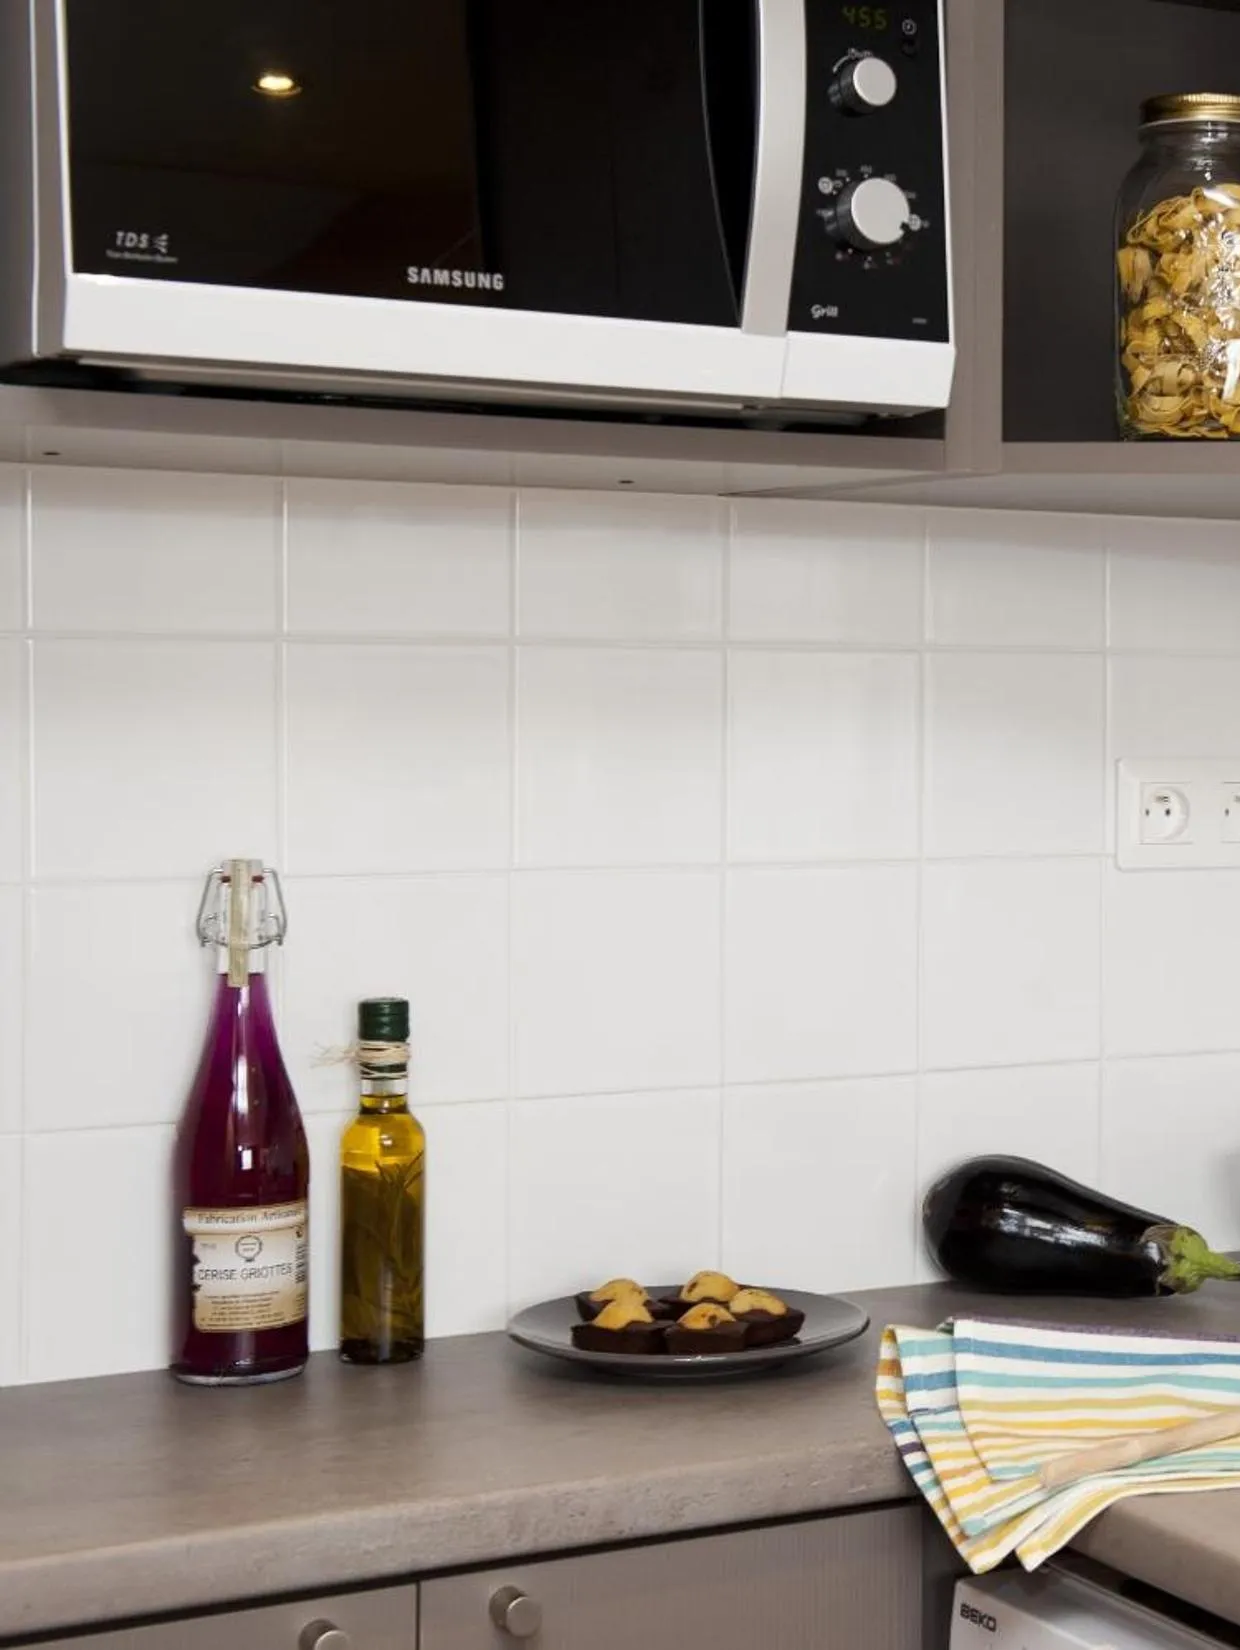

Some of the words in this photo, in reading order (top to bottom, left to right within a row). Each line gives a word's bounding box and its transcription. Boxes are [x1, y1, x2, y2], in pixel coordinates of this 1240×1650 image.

[116, 231, 149, 248] TDS
[407, 267, 504, 290] SAMSUNG
[810, 304, 839, 321] Grill
[197, 1212, 257, 1225] Fabrication
[198, 1268, 236, 1281] CERISE
[240, 1262, 293, 1280] GRIOTTES
[960, 1603, 997, 1632] BEKO
